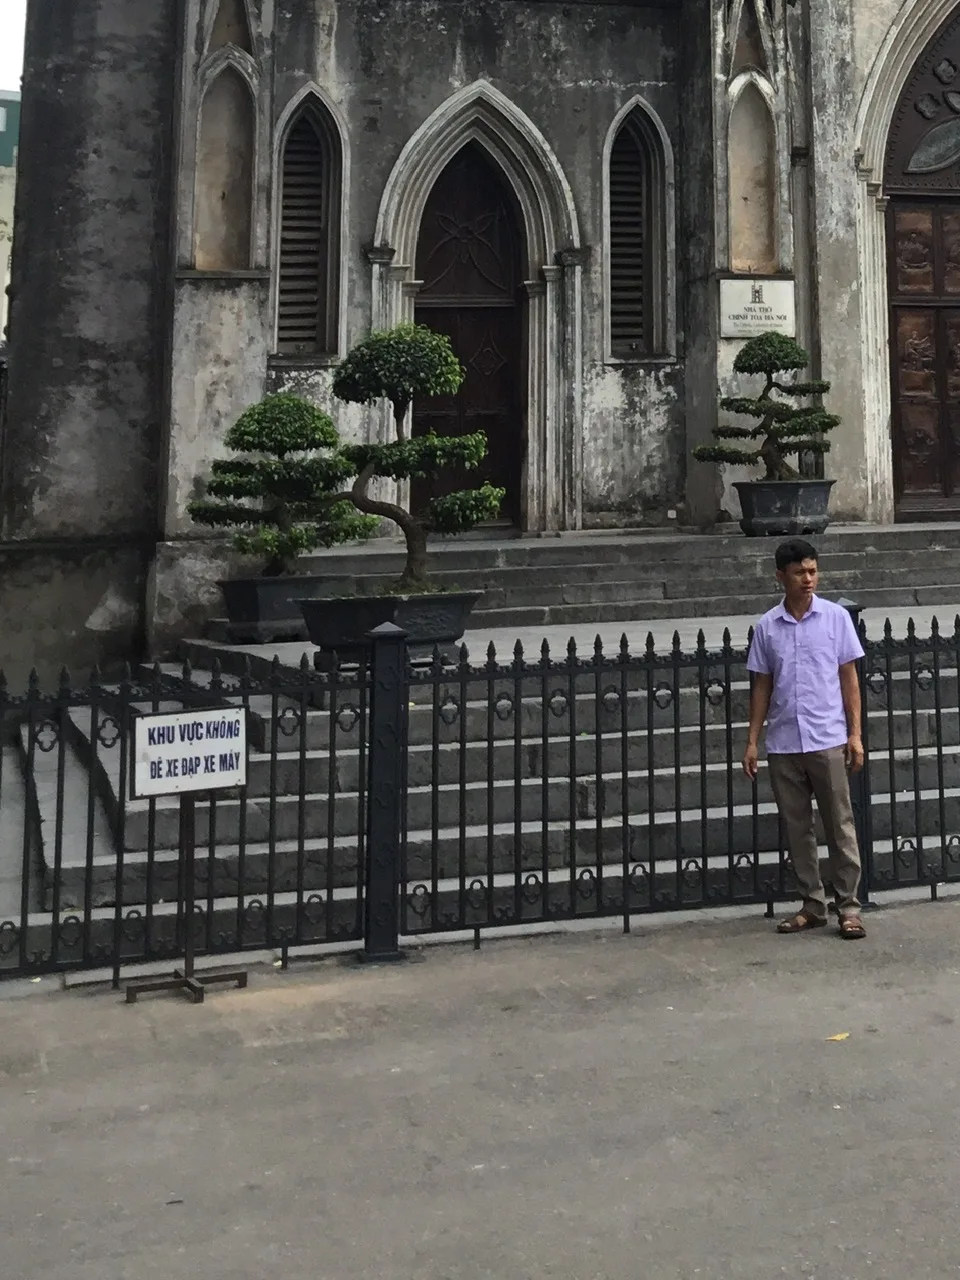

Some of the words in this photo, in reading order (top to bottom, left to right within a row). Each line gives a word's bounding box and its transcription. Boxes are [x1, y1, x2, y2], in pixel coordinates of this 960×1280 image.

[148, 726, 175, 745] KHU
[179, 720, 203, 745] VỰC
[205, 716, 240, 739] KHÔNG
[165, 758, 179, 778] XE
[181, 756, 201, 779] ĐẠP
[203, 755, 216, 773] XE
[219, 749, 241, 772] MÁY
